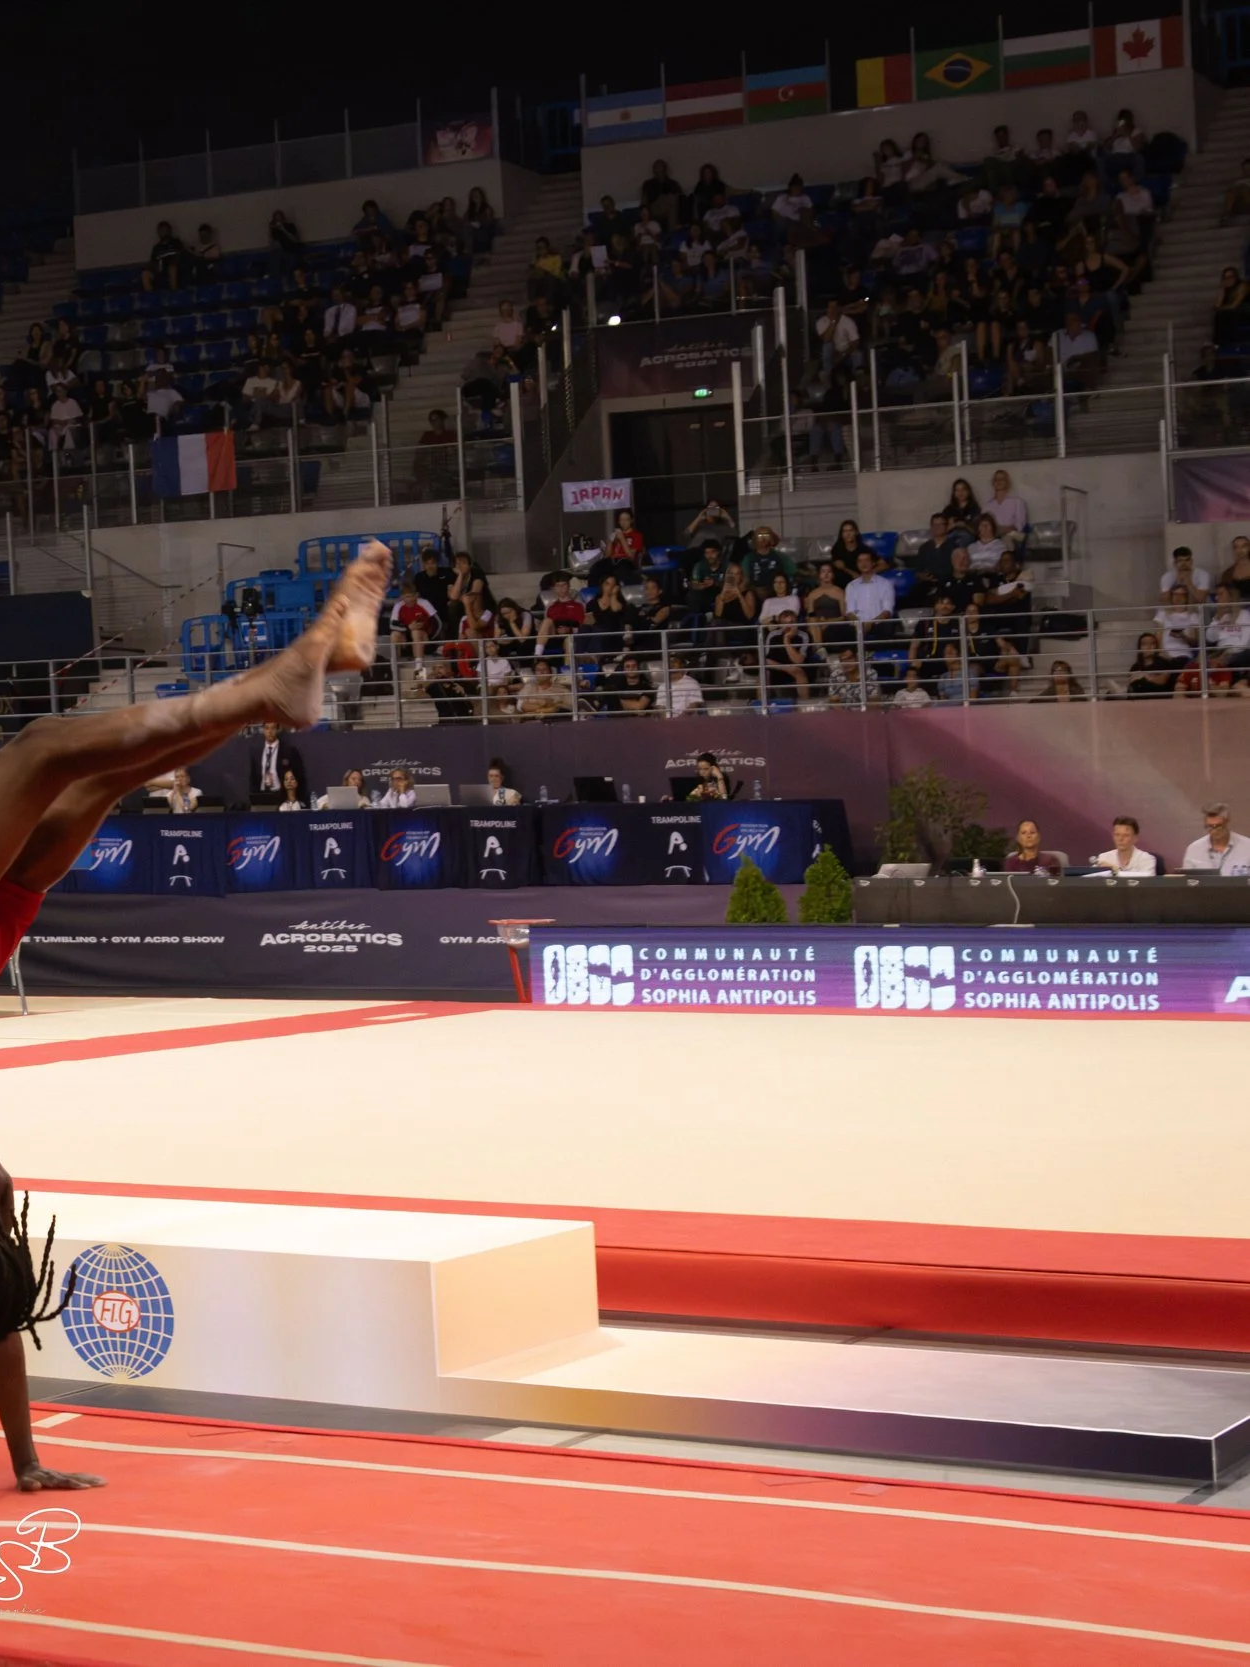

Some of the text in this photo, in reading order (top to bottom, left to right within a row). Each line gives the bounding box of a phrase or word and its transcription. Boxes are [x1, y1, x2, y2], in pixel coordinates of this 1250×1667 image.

[571, 486, 624, 505] JAPAN
[470, 819, 517, 828] TRAMPOLINE
[651, 814, 702, 824] TRAMPOLINE
[308, 821, 354, 831] TRAMPOLINE
[160, 829, 203, 838] TRAMPOLINE
[33, 935, 98, 943] TUMBLING
[111, 935, 141, 943] GYM
[143, 935, 180, 943] ACRO
[182, 935, 225, 943] SHOW
[260, 933, 403, 946] ACROBATICS
[439, 935, 472, 944] GYM
[303, 944, 359, 953] 2025
[639, 945, 816, 961] COMMUNAUTÉ
[961, 946, 1159, 964] COMMUNAUTÉ
[640, 965, 817, 982] D'AGGLOMÉRATION
[962, 968, 1160, 986] D'AGGLOMÉRATION
[641, 988, 817, 1005] SOPHIA ANTIPOLIS
[963, 991, 1161, 1011] SOPHIA ANTIPOLIS
